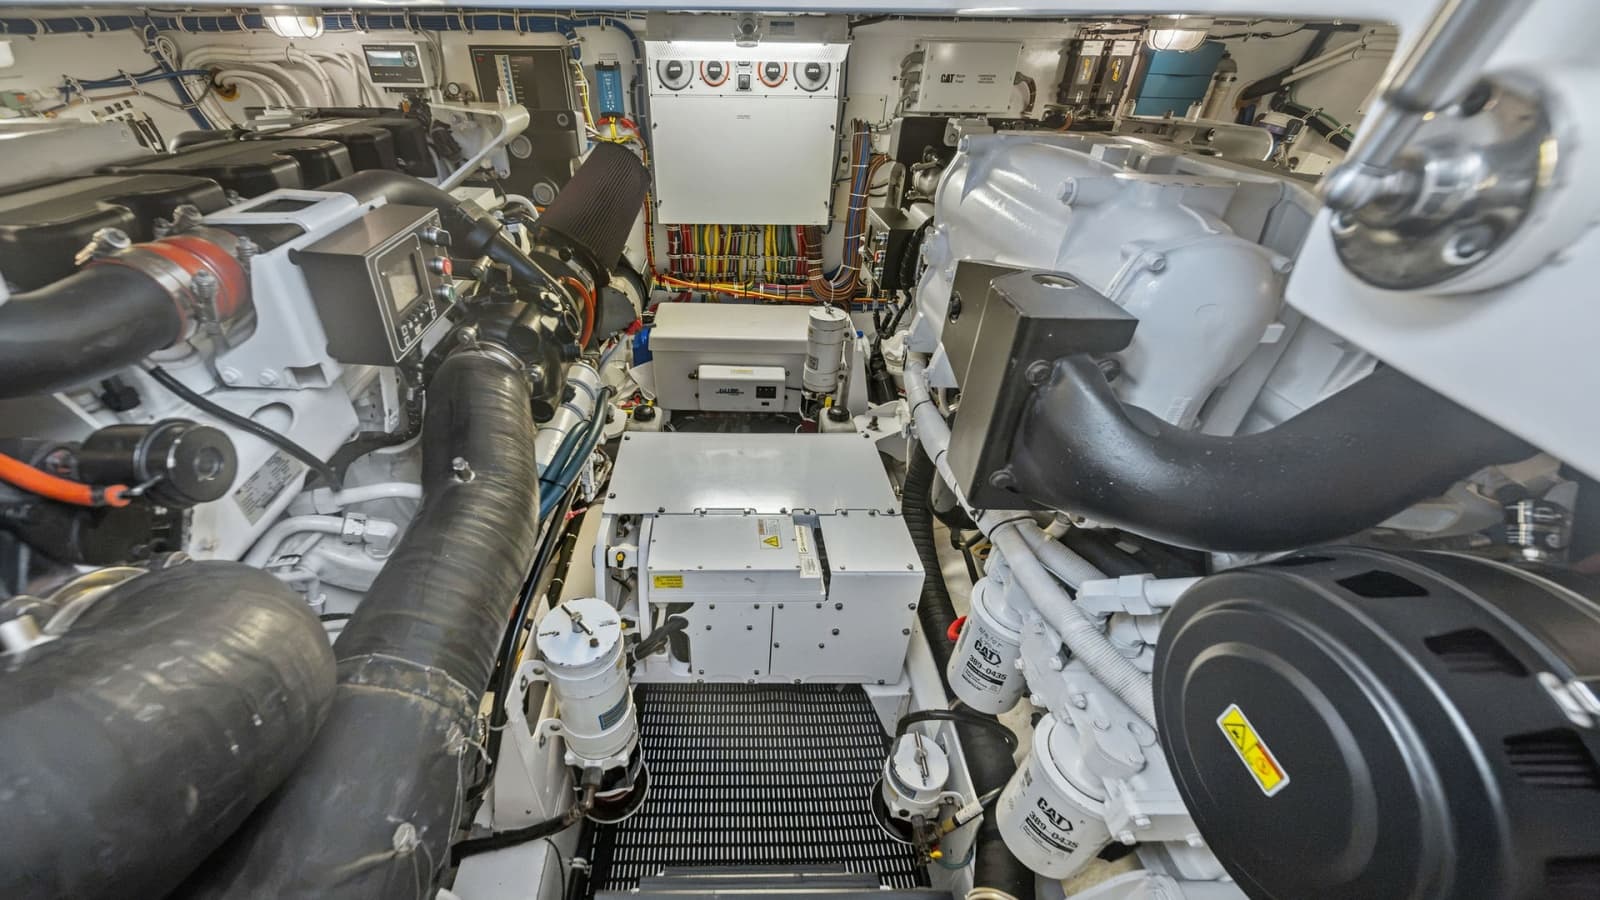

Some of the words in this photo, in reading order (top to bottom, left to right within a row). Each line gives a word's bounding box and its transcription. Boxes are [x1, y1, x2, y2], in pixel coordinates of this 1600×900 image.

[940, 73, 955, 83] CAT
[974, 640, 1000, 664] CAT
[969, 655, 1008, 680] 389-0435
[1037, 797, 1072, 830] CAT
